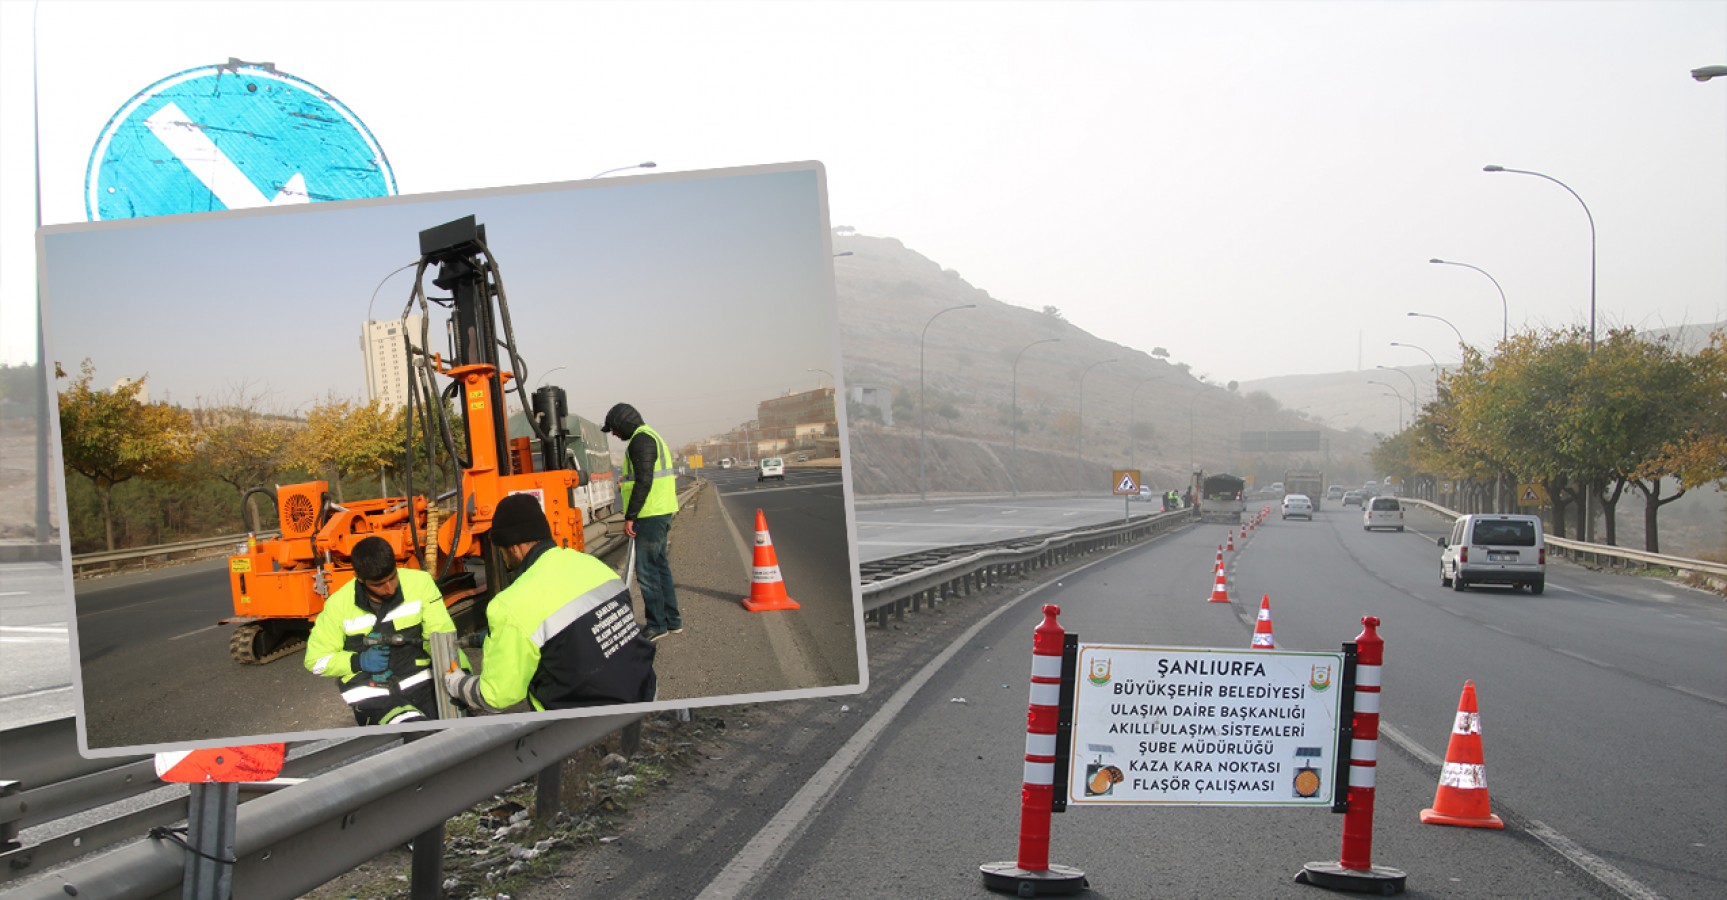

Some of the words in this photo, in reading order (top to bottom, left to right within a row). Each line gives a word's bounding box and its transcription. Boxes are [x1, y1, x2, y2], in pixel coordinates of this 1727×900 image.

[1158, 659, 1266, 678] ŞANLIURFA
[1113, 679, 1213, 699] BÜYÜKŞEHİR
[1219, 683, 1305, 699] BELEDİYESİ
[1111, 704, 1167, 719] ULAŞIM
[1174, 703, 1215, 717] DAİRE
[1221, 704, 1305, 720] BAŞKANLIĞI
[1109, 723, 1158, 735] AKILLI
[1160, 724, 1216, 738] ULAŞIM
[1221, 722, 1305, 737] SİSTEMLERİ
[1139, 742, 1176, 756] ŞUBE
[1182, 739, 1273, 755] MÜDÜRLÜĞÜ
[1129, 760, 1169, 772] KAZA
[1174, 761, 1213, 773] KARA
[1219, 762, 1280, 773] NOKTASI
[1133, 776, 1190, 793] FLAŞÖR
[1196, 778, 1274, 793] ÇALIŞMASI
